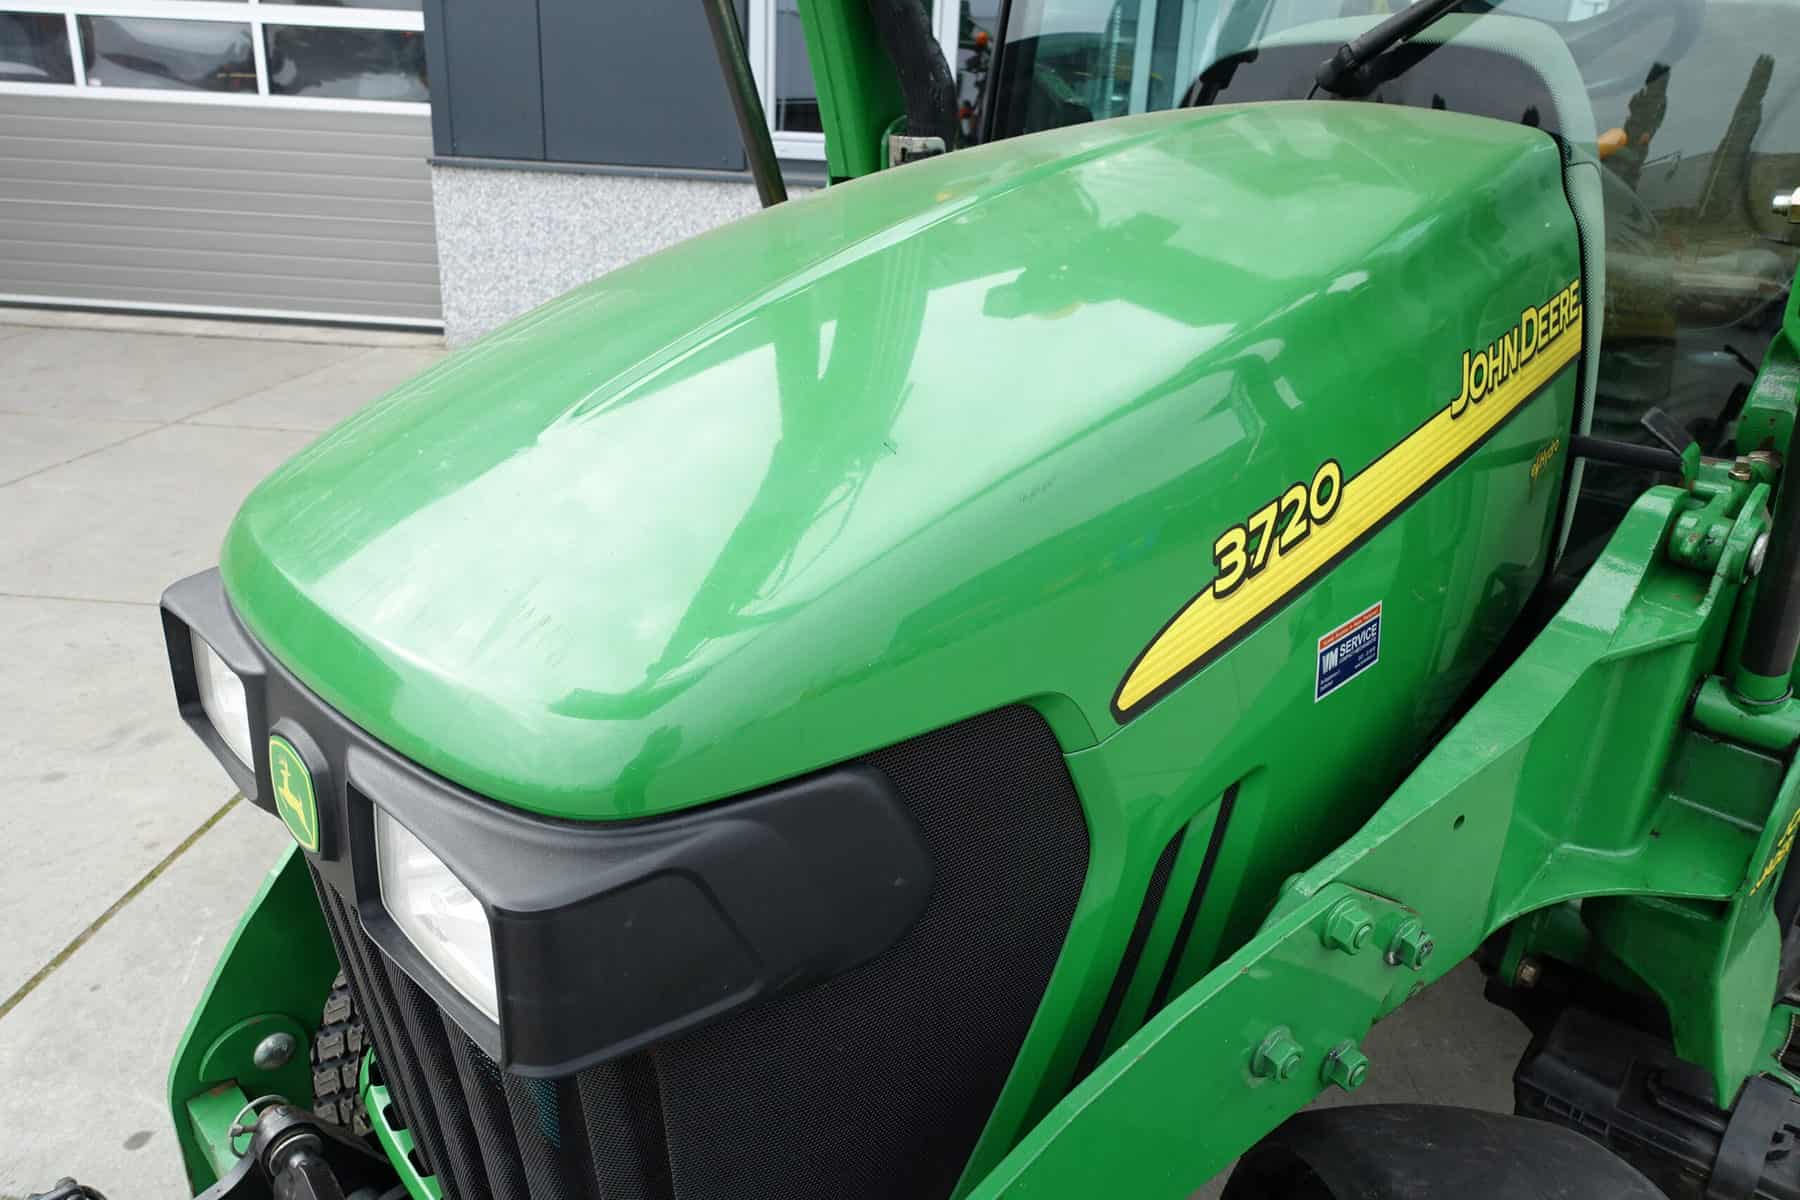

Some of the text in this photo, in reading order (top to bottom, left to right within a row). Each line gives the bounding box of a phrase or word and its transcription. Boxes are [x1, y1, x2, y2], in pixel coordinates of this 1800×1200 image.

[1451, 279, 1580, 419] JOHN DEERE
[1213, 459, 1344, 598] 3720
[1322, 647, 1339, 674] VM
[1340, 623, 1378, 657] SERVICE
